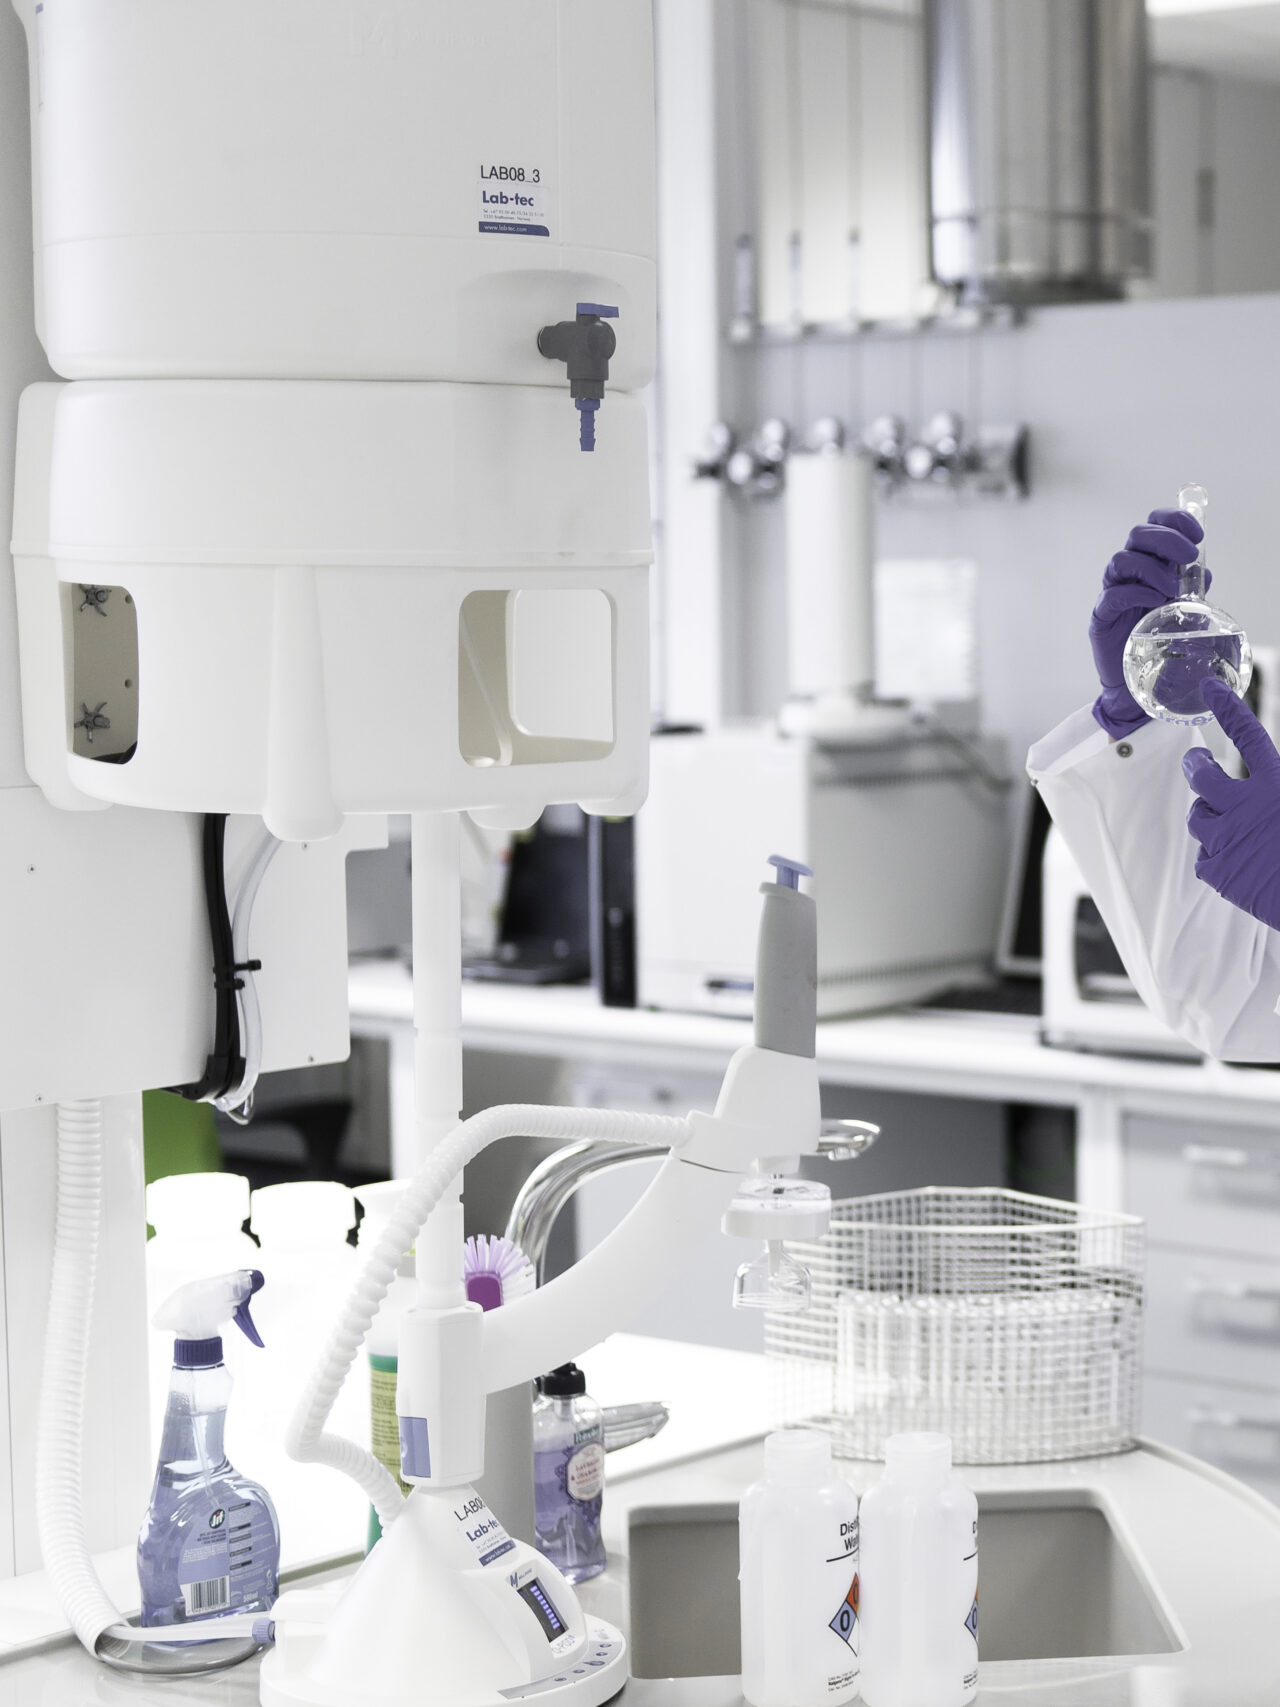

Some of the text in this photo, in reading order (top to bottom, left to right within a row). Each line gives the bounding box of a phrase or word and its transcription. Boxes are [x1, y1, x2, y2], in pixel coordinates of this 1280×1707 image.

[481, 165, 540, 183] LAB08_3
[482, 190, 534, 206] Lab-tec
[211, 1511, 224, 1527] Jif
[840, 1609, 850, 1632] 0
